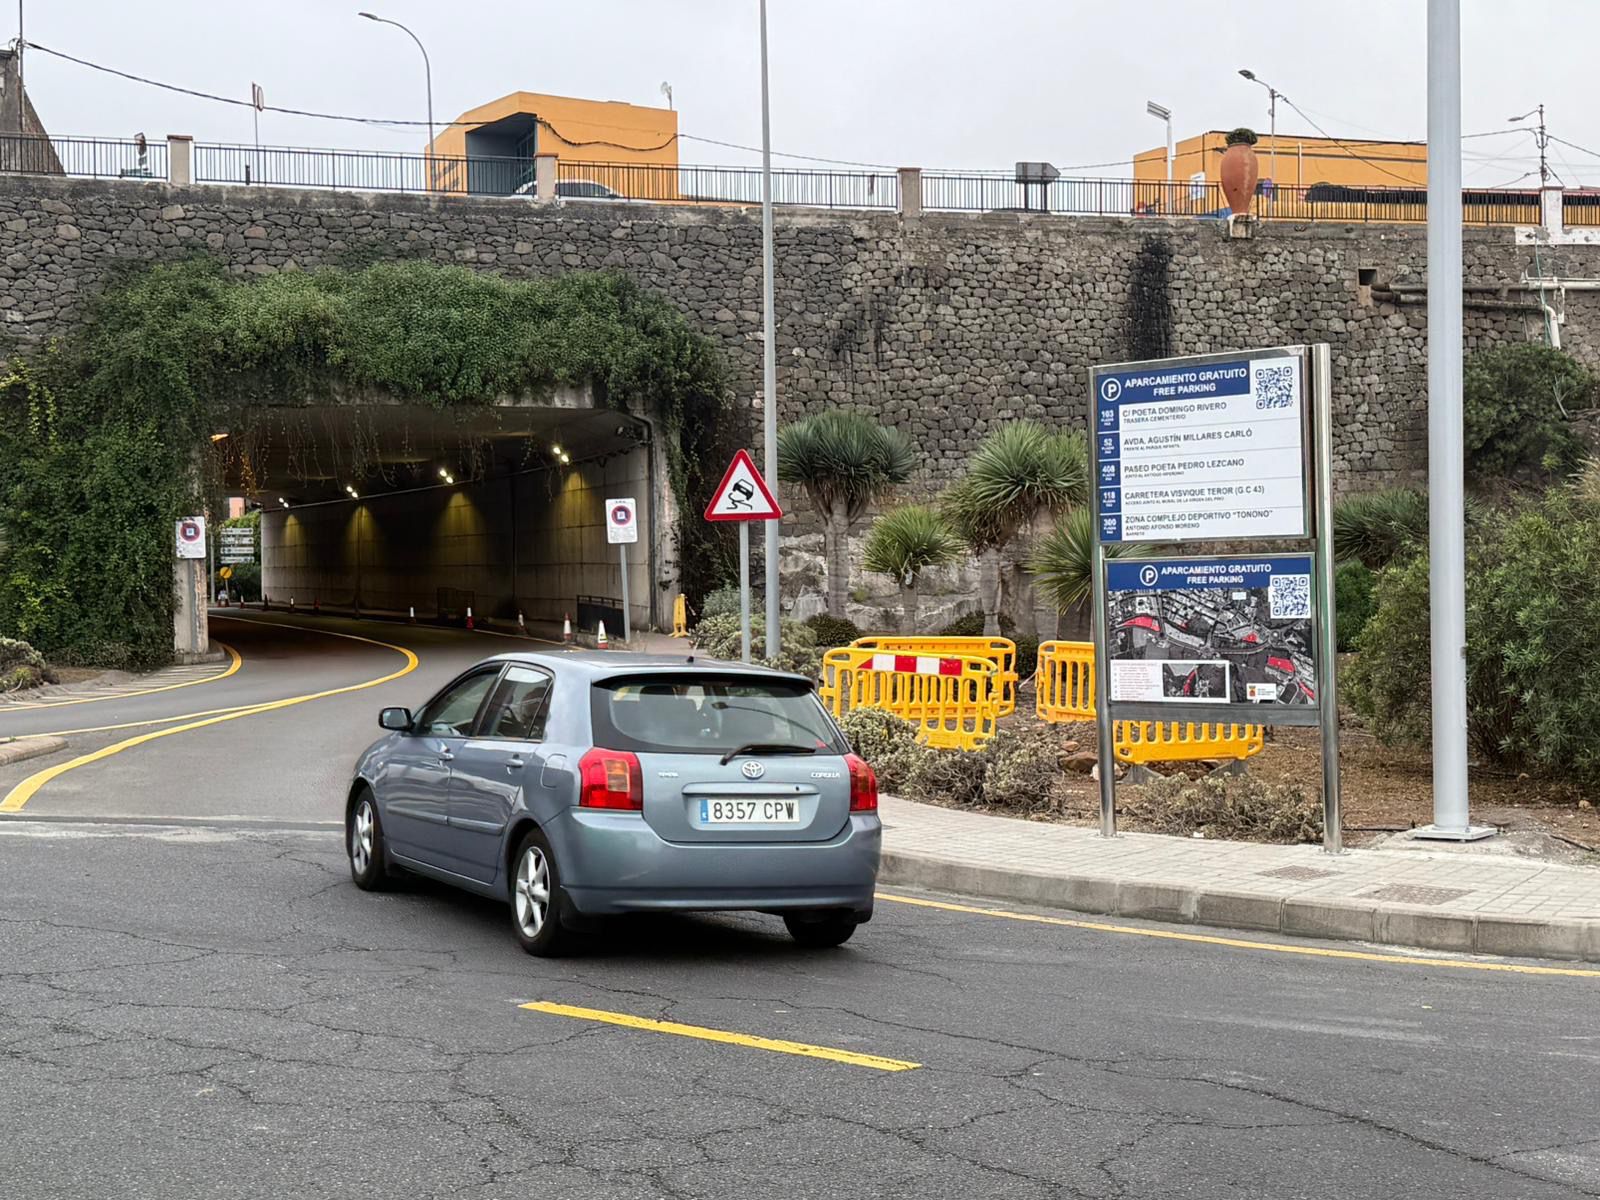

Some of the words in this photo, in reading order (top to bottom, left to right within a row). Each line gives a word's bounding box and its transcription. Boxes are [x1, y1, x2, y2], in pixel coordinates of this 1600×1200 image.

[1124, 373, 1197, 388] APARCAMIENTO
[1198, 368, 1247, 381] GRATUITO
[1153, 386, 1176, 396] FREE
[1177, 383, 1216, 394] PARKING
[1101, 410, 1114, 418] 103
[1131, 407, 1157, 417] POETA
[1158, 404, 1195, 415] DOMINGO
[1196, 402, 1227, 411] RIVERO
[1150, 414, 1186, 422] CEMENTERIO
[1103, 438, 1113, 446] 52
[1123, 438, 1146, 446] AVDA.
[1148, 434, 1181, 444] AGUSTÍN
[1183, 431, 1222, 441] MILLARES
[1224, 427, 1252, 439] CARLÓ
[1124, 464, 1149, 473] PASEO
[1151, 463, 1176, 472] POETA
[1177, 461, 1205, 470] PEDRO
[1206, 458, 1245, 468] LEZCANO
[1103, 491, 1116, 499] 118
[1124, 490, 1170, 500] CARRETERA
[1170, 488, 1205, 498] VISVIQUE
[1207, 486, 1233, 496] TEROR
[1125, 516, 1146, 524] ZONA
[1146, 513, 1186, 523] COMPLEJO
[1187, 511, 1231, 521] DEPORTIVO
[1160, 565, 1226, 575] APARCAMIENTO
[1228, 563, 1272, 573] GRATUITO
[1186, 575, 1207, 584] FREE
[1208, 575, 1244, 584] PARKING
[810, 771, 841, 779] COROLLA
[713, 802, 756, 819] 8357
[763, 802, 795, 819] CPW
